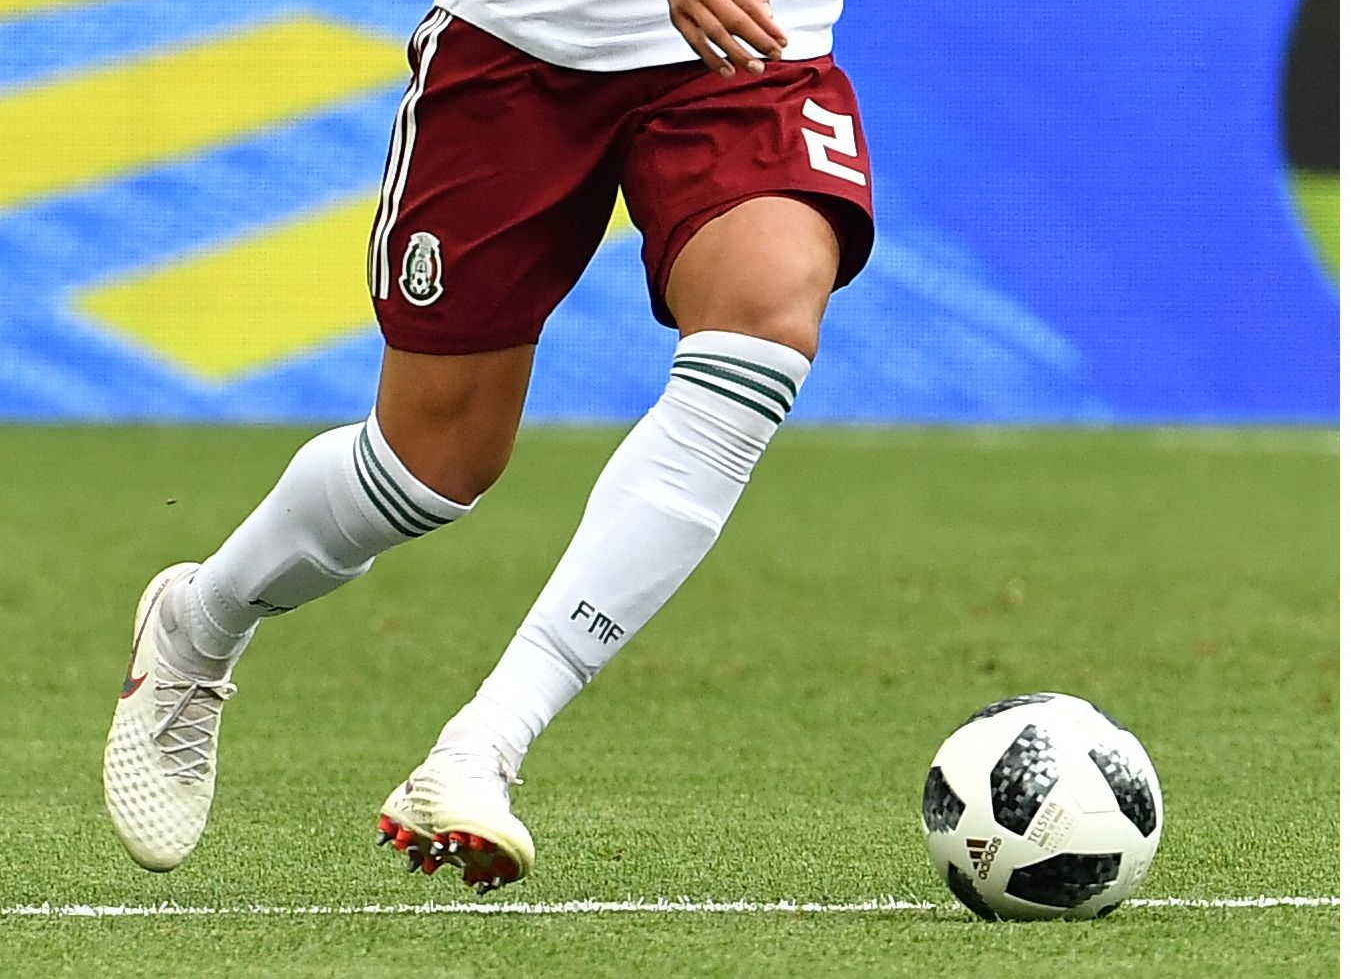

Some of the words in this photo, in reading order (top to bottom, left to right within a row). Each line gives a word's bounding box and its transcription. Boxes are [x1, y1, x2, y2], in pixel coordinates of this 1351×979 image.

[570, 599, 625, 645] FMF
[1027, 802, 1060, 843] TELSTRA
[978, 836, 1002, 880] adidas
